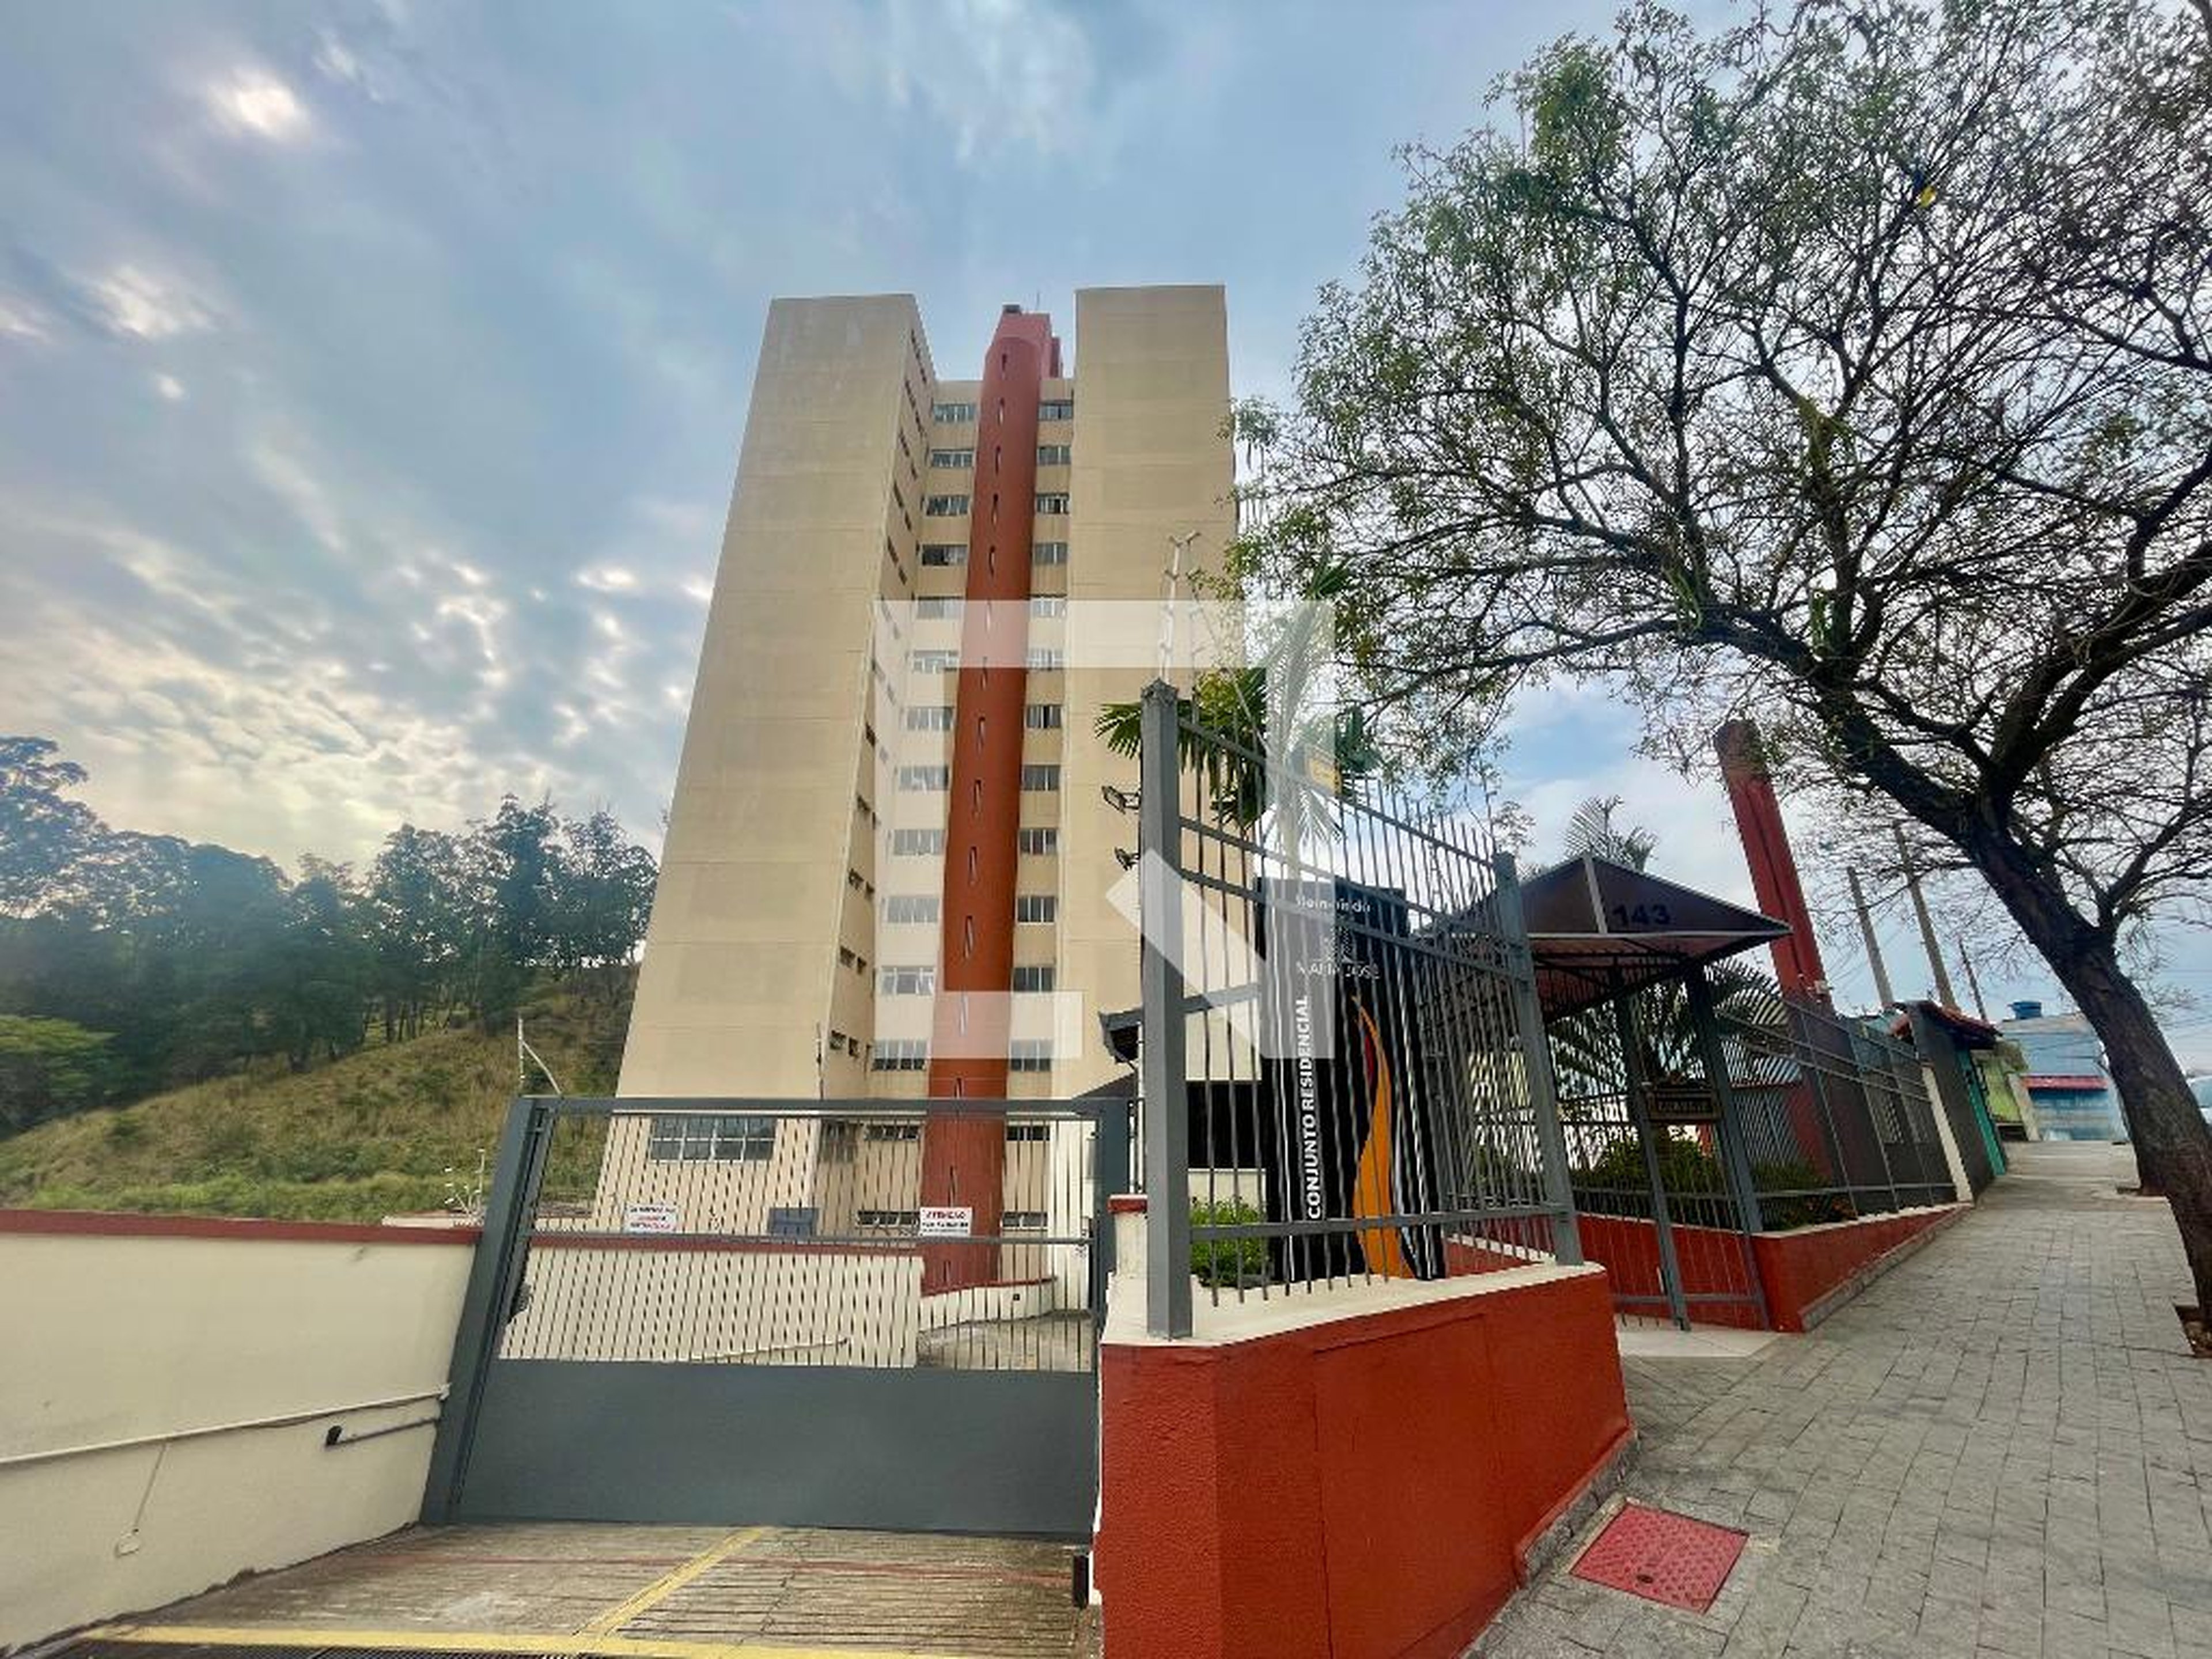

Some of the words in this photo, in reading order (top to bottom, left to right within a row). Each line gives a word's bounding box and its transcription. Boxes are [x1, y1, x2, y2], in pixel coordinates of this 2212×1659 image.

[1613, 904, 1671, 926] 143
[1296, 995, 1315, 1111] RESIDENCIAL
[1302, 1113, 1321, 1219] CONJUNTO
